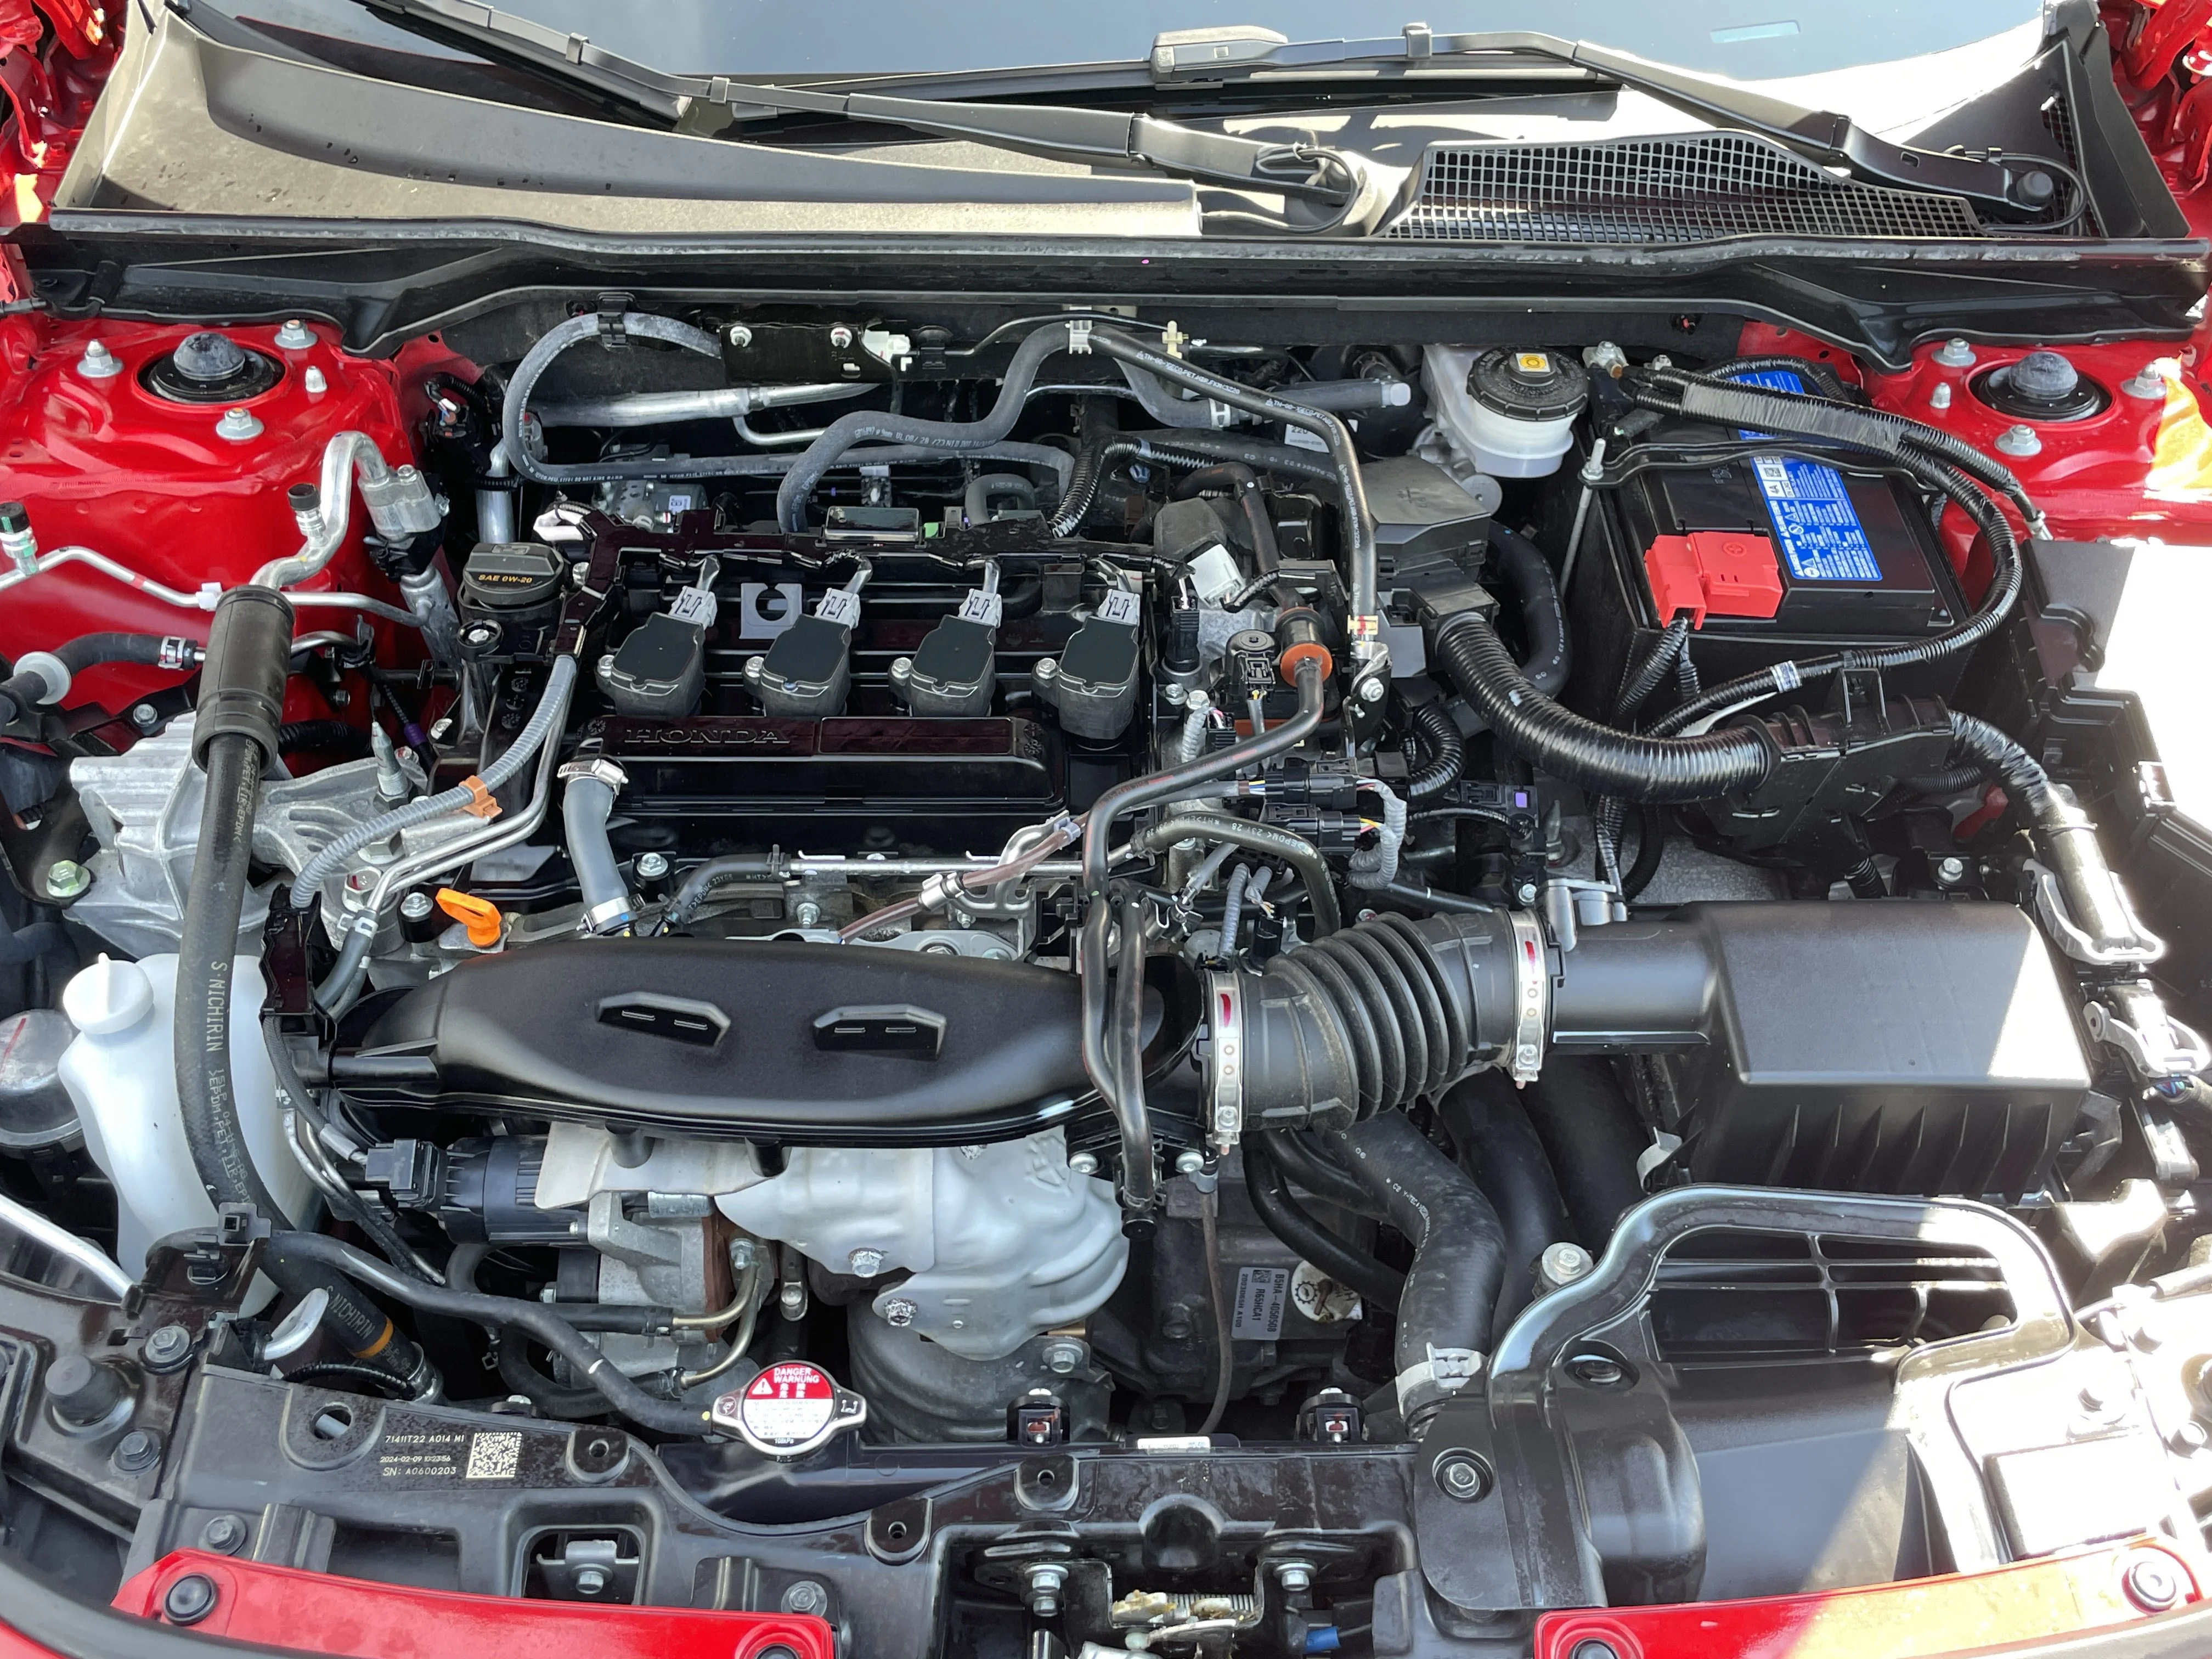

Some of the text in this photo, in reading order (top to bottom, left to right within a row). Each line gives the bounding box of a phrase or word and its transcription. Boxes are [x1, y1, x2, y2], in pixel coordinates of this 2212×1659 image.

[624, 729, 791, 744] HONDA
[1232, 822, 1242, 832] 28
[1251, 1288, 1265, 1321] R65HCA1
[774, 1367, 811, 1376] DANGER
[774, 1375, 820, 1384] WARNUNG
[385, 1434, 465, 1443] 71411T22 A014 M1
[383, 1466, 457, 1476] SN: A0600203
